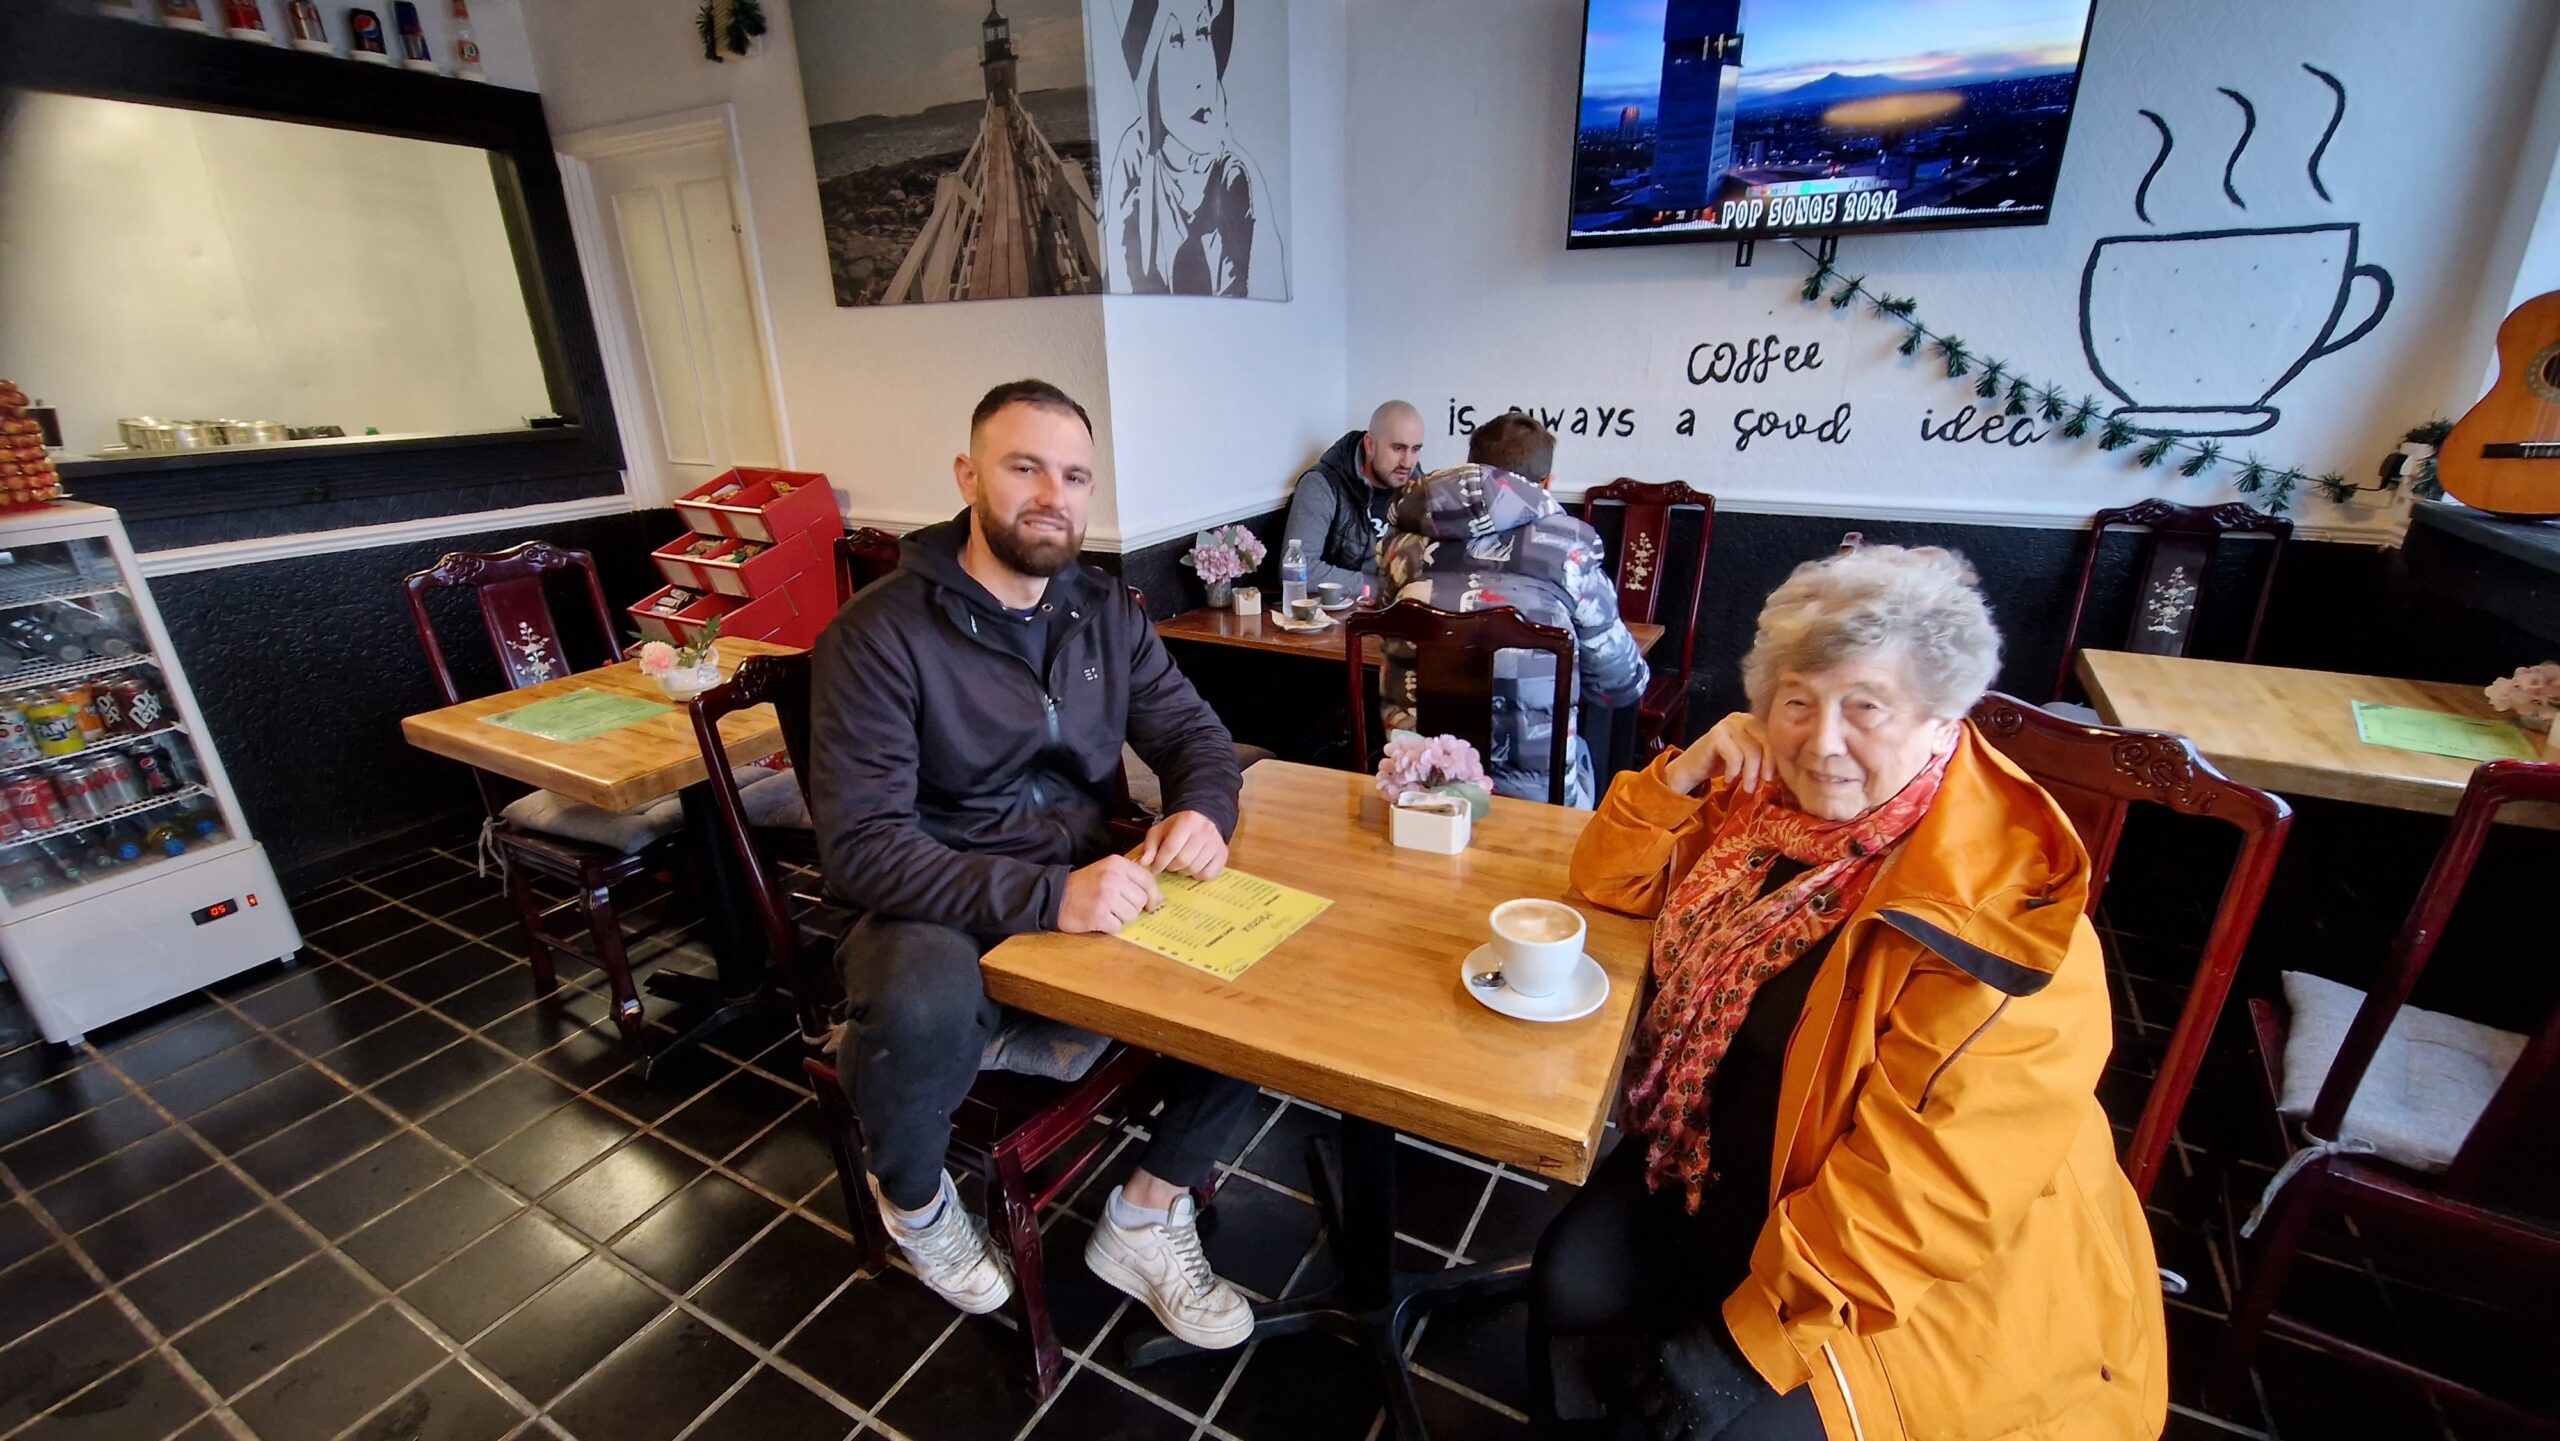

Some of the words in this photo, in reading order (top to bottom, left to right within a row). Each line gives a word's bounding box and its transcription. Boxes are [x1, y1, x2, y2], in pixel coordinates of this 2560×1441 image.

[1721, 200, 1764, 230] POP
[1767, 195, 1838, 227] SONGS
[1843, 189, 1898, 222] 2024
[1449, 398, 1475, 436] is
[1508, 405, 1636, 438] ways
[1676, 408, 1696, 437] a
[1733, 403, 1851, 452] good
[1921, 405, 2050, 446] idea
